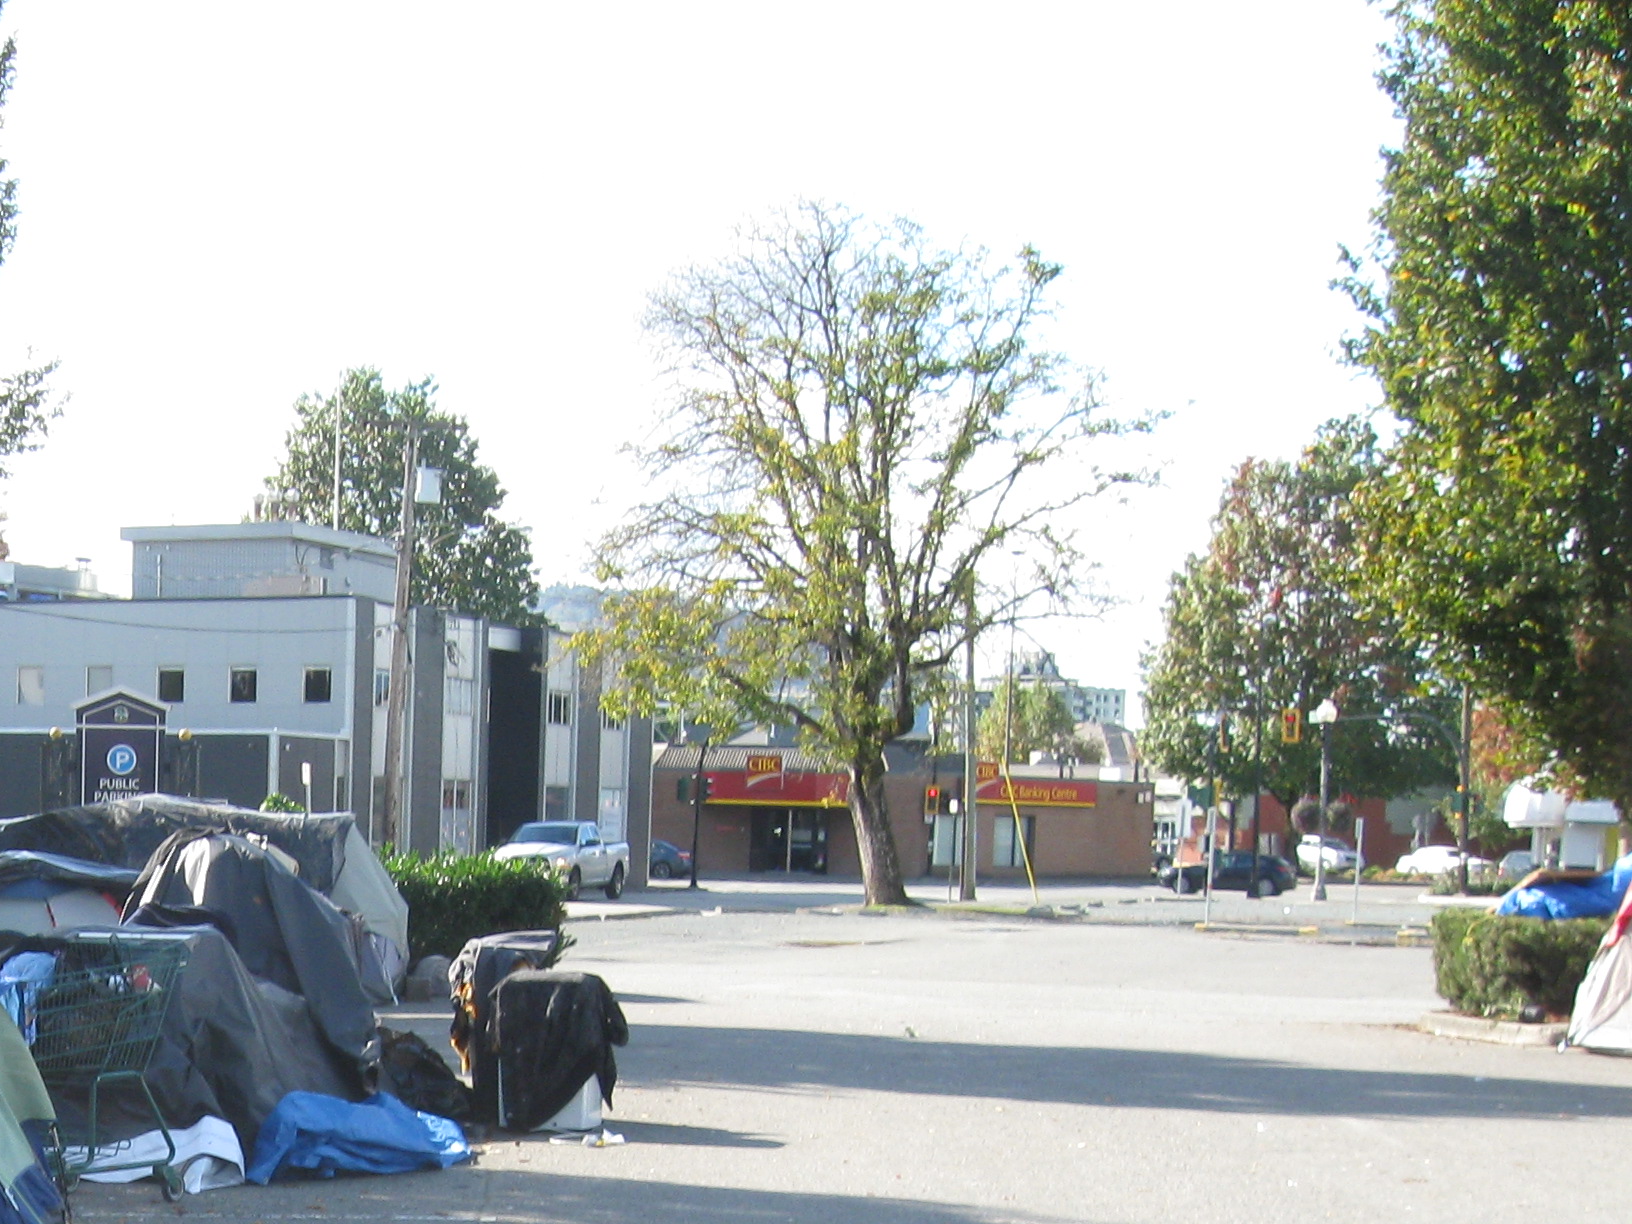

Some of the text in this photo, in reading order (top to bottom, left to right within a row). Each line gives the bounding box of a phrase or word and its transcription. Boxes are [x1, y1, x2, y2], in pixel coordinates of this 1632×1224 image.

[749, 757, 781, 772] CIBC
[976, 765, 999, 778] CIBC
[99, 778, 139, 790] PUBLIC
[94, 791, 143, 803] PARKIN
[1020, 786, 1050, 801] Banking
[1052, 787, 1078, 800] Centre
